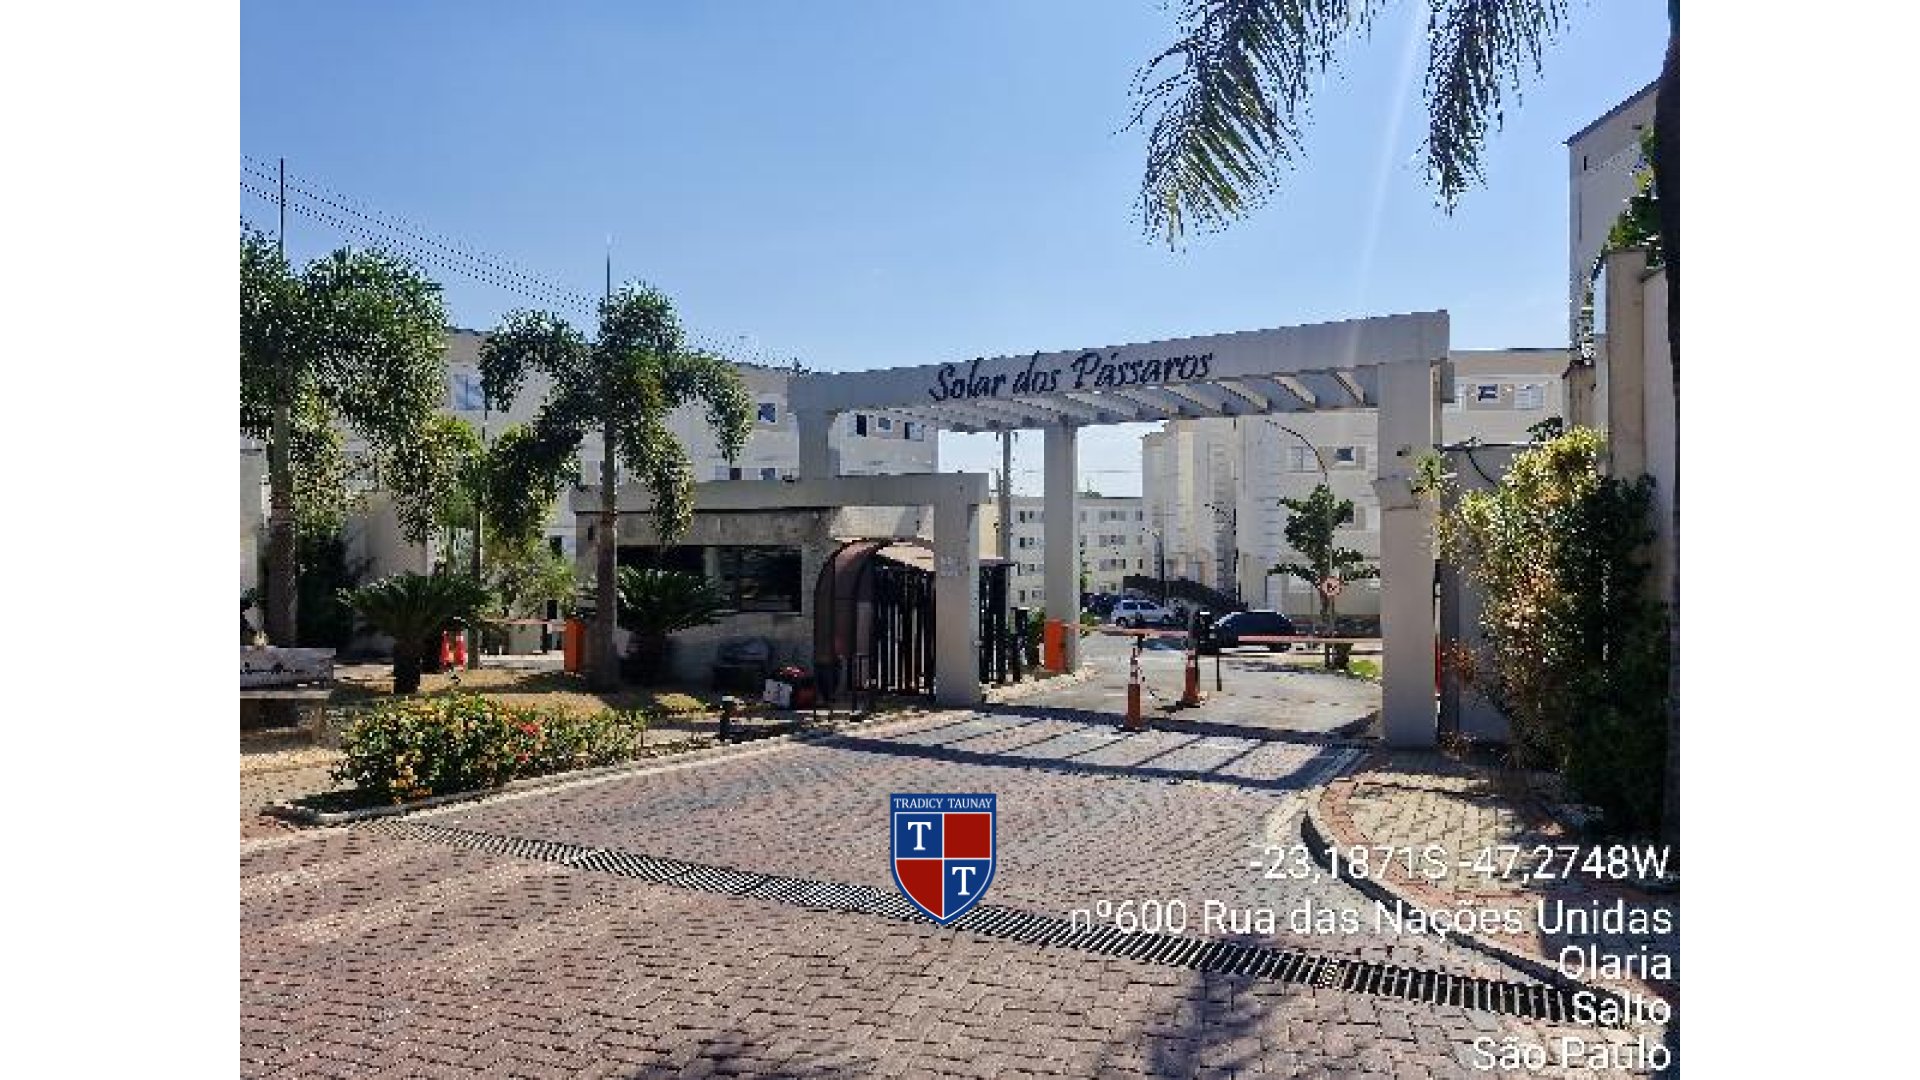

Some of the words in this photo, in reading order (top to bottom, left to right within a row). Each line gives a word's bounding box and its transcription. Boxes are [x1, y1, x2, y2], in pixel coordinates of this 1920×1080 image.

[929, 357, 1006, 401] Solar
[1012, 350, 1061, 395] dos
[1069, 351, 1213, 389] Pássaros
